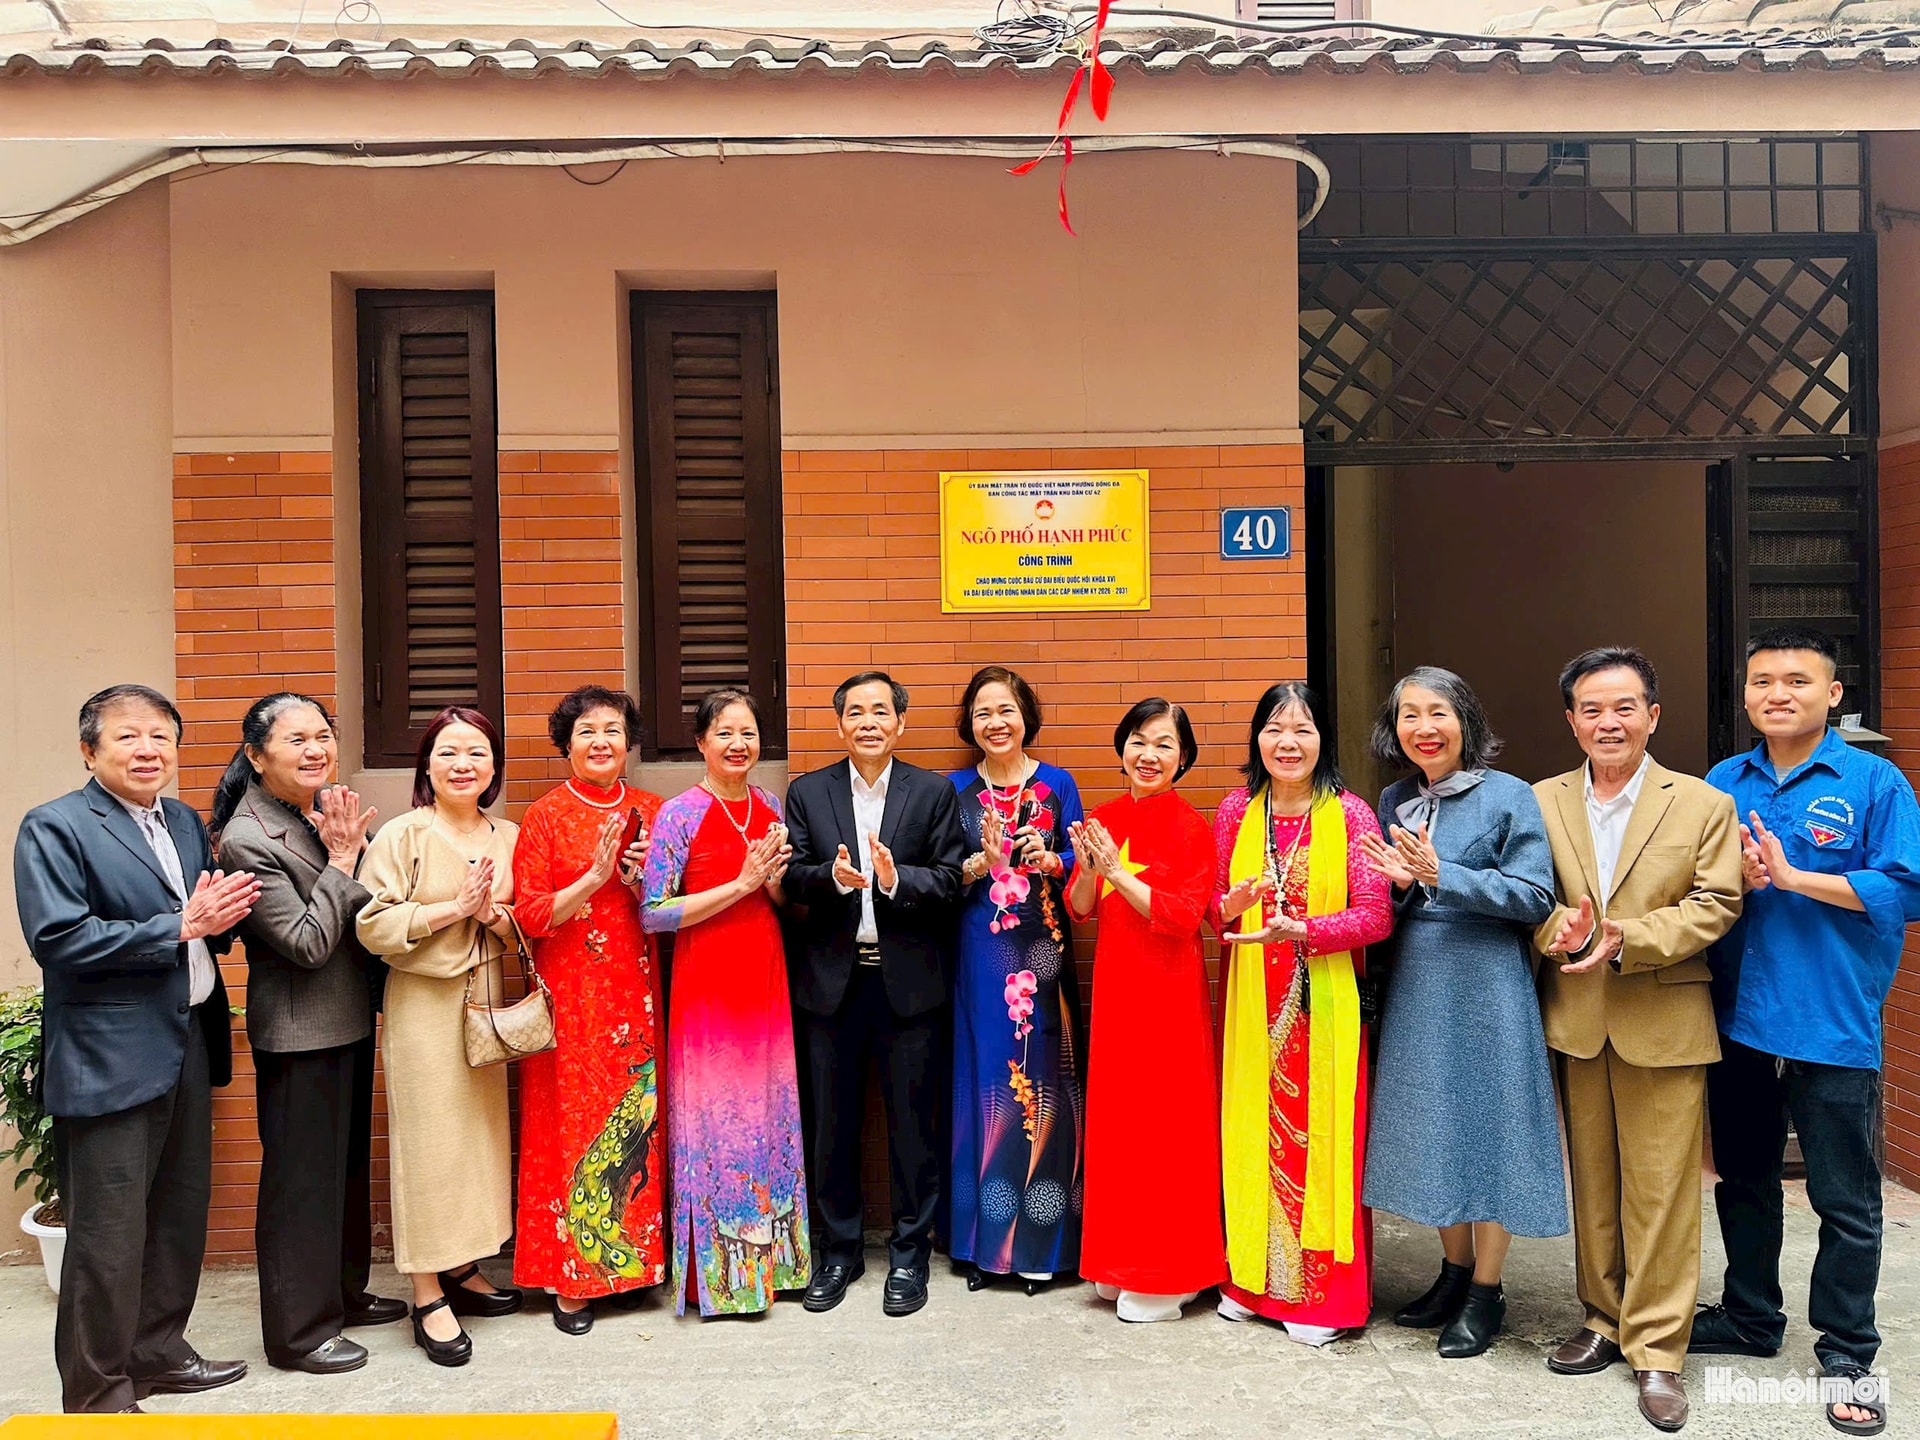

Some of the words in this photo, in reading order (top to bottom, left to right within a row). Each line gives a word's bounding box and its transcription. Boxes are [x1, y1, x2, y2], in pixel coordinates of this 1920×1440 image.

[962, 527, 996, 544] NGÕ
[1000, 523, 1034, 544] PHỐ
[1039, 529, 1083, 547] HẠNH
[1088, 524, 1132, 543] PHÚC
[1233, 515, 1276, 550] 40
[1018, 554, 1043, 566] CÔNG
[1046, 553, 1072, 566] TRÌNH
